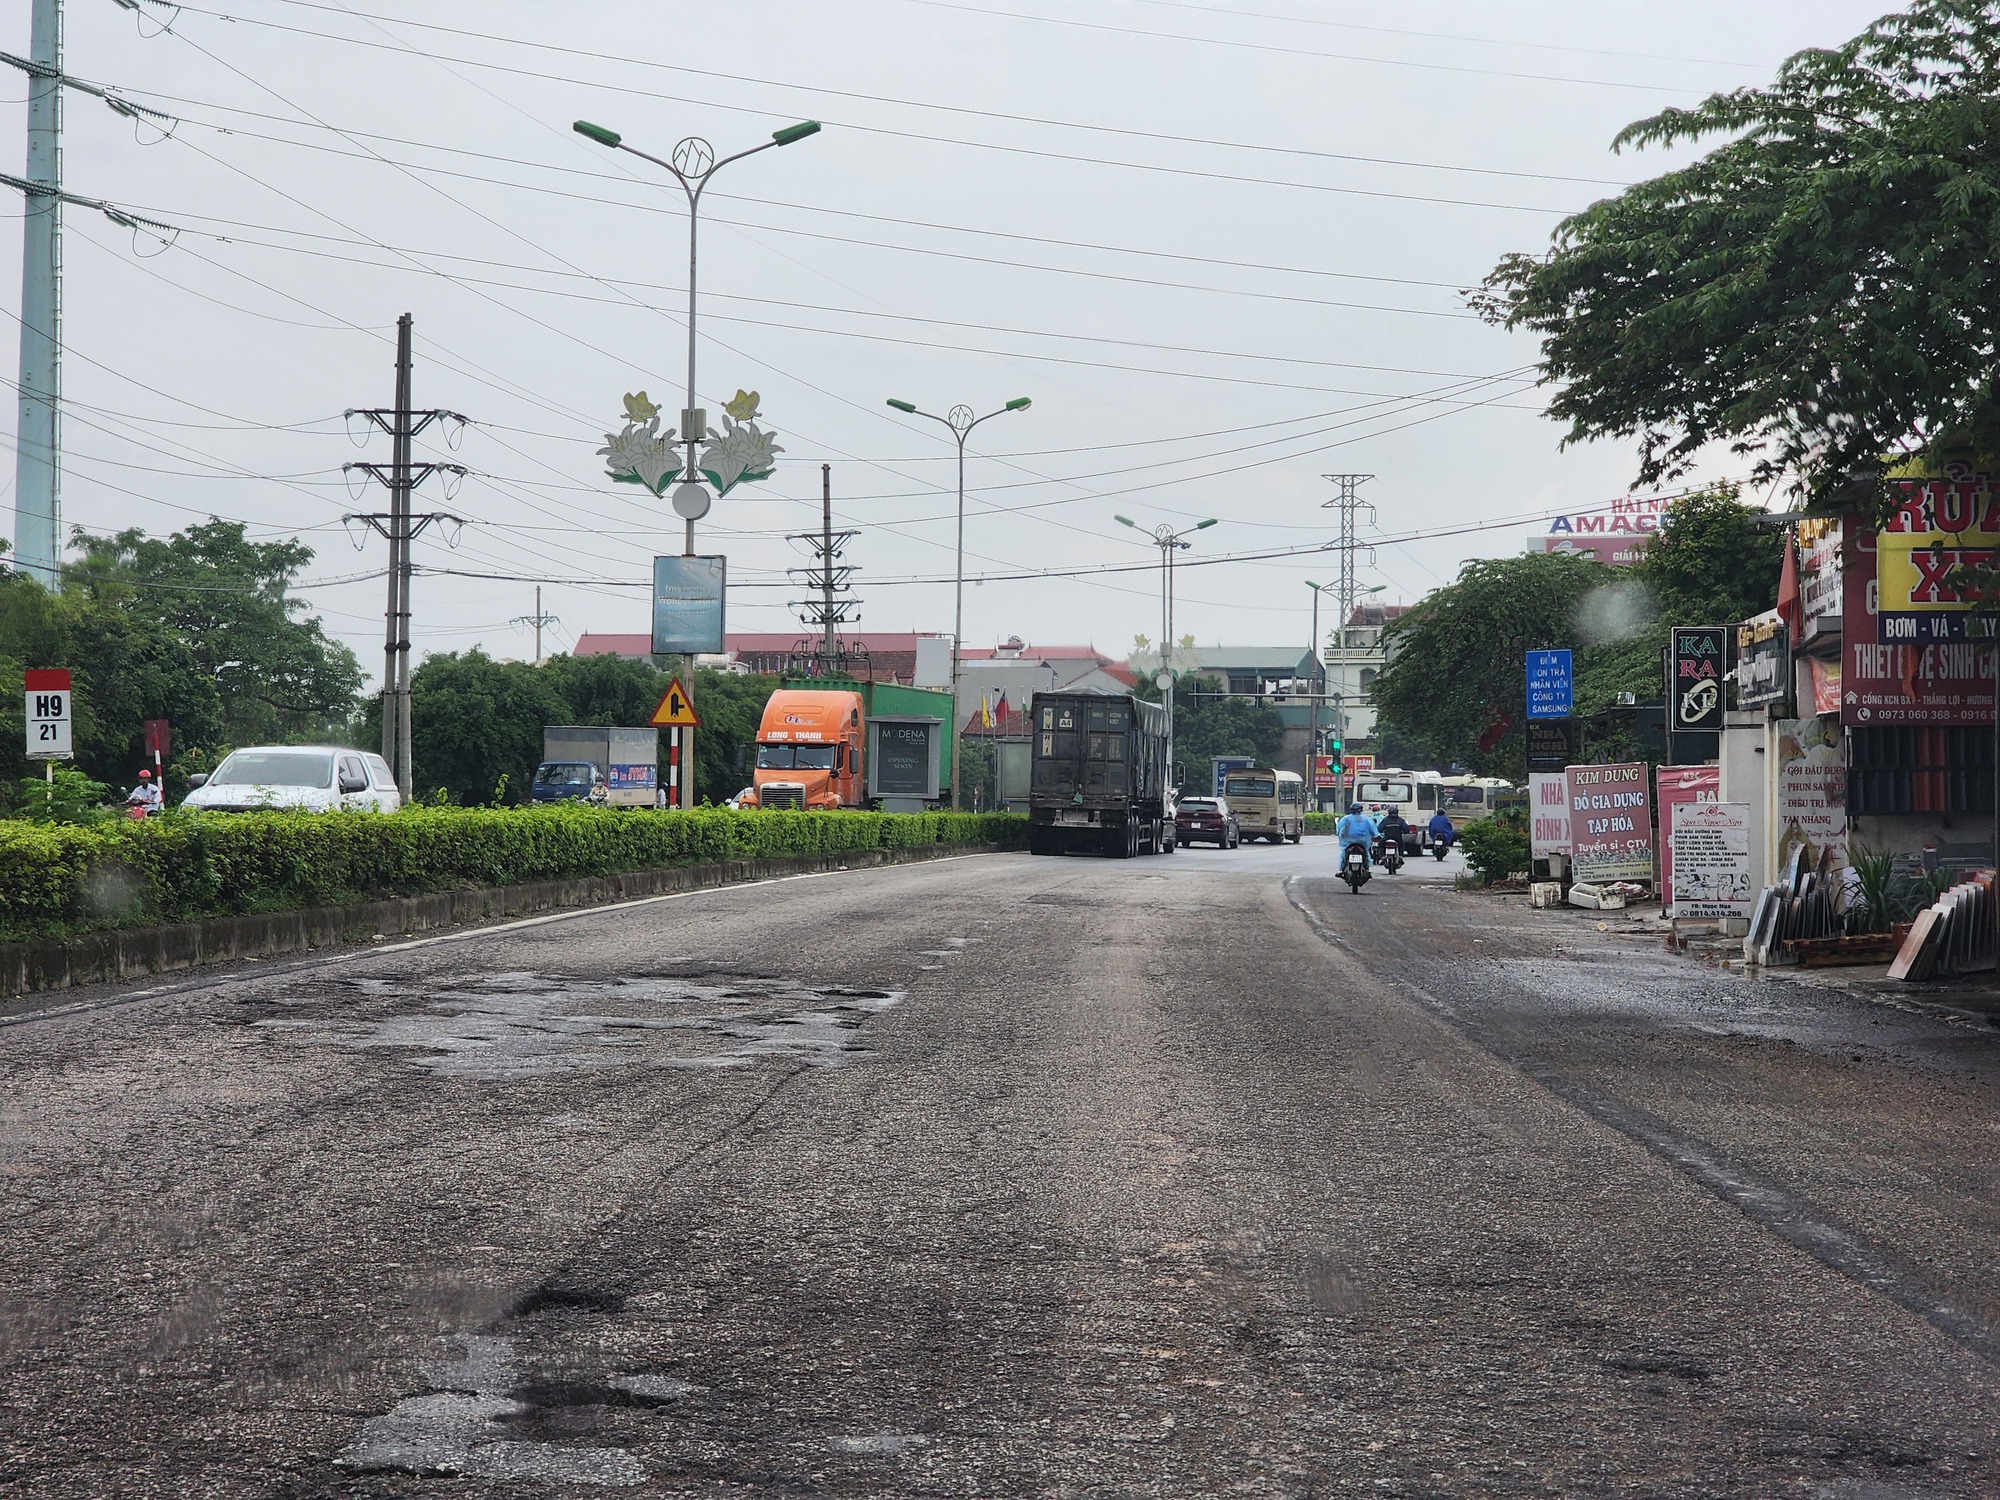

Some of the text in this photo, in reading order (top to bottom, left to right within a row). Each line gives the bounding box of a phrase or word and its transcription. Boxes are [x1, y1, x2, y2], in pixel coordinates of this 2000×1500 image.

[1611, 493, 1641, 513] HẢI
[1885, 617, 1917, 637] BƠM
[1930, 614, 1949, 637] VÁ
[1679, 636, 1718, 658] KA
[1679, 659, 1718, 680] RA
[1939, 644, 1974, 679] SINH
[1533, 690, 1553, 701] CÔNG
[1884, 695, 1900, 705] KCN
[36, 695, 62, 717] H9
[1532, 704, 1568, 713] SAMSUNG
[1878, 710, 1905, 719] 0973
[1908, 710, 1928, 719] 060
[1930, 710, 1950, 719] 368
[1961, 710, 1987, 719] 0916
[1061, 719, 1071, 727] A4
[40, 724, 57, 740] 21
[767, 731, 788, 739] LONG
[1575, 768, 1639, 785] KIM DUNG
[1683, 772, 1700, 780] B2C
[1541, 778, 1564, 805] NHÀ
[1787, 783, 1811, 792] PHUN
[1573, 789, 1644, 811] ĐỒ GIA DỤNG
[1535, 814, 1562, 841] BÌNH
[1587, 813, 1634, 837] TẠP HÓA
[1801, 815, 1831, 825] NHANG
[1577, 839, 1607, 853] Tuyển
[1626, 839, 1647, 848] CTV
